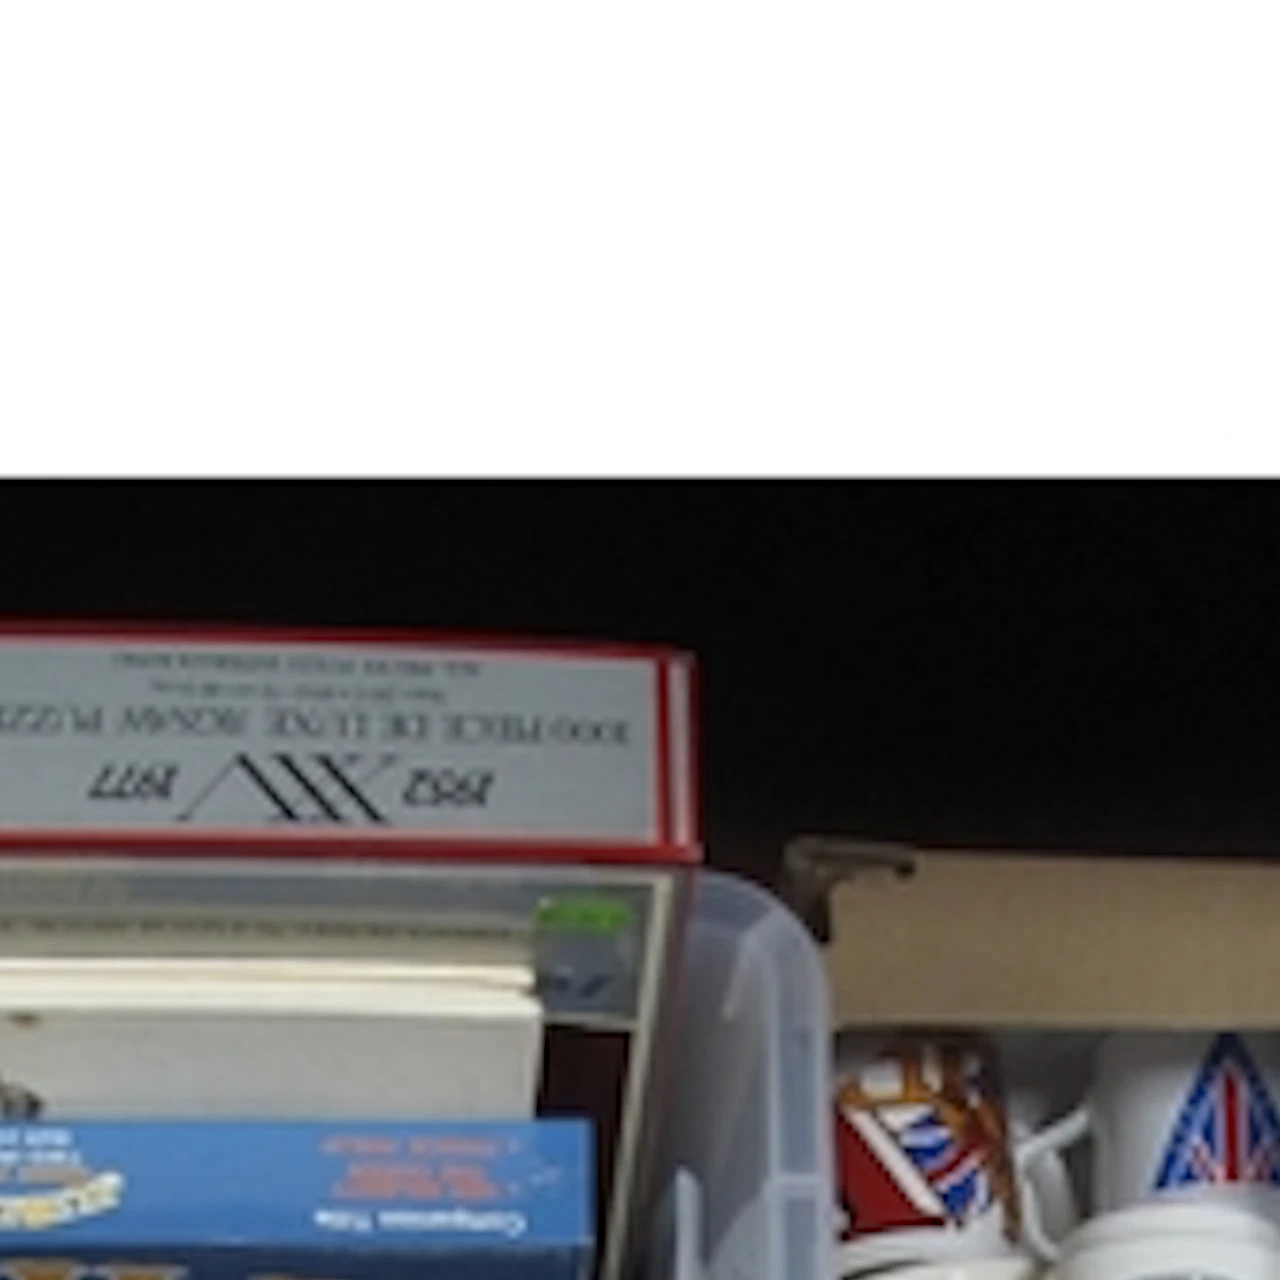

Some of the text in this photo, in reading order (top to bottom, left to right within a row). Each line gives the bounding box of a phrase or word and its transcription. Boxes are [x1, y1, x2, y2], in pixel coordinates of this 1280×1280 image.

[118, 704, 249, 736] JIGSAW
[273, 705, 366, 738] LUXE
[381, 709, 430, 740] DE
[437, 710, 542, 742] PIECE
[87, 762, 178, 801] 1977
[404, 768, 495, 808] 1952
